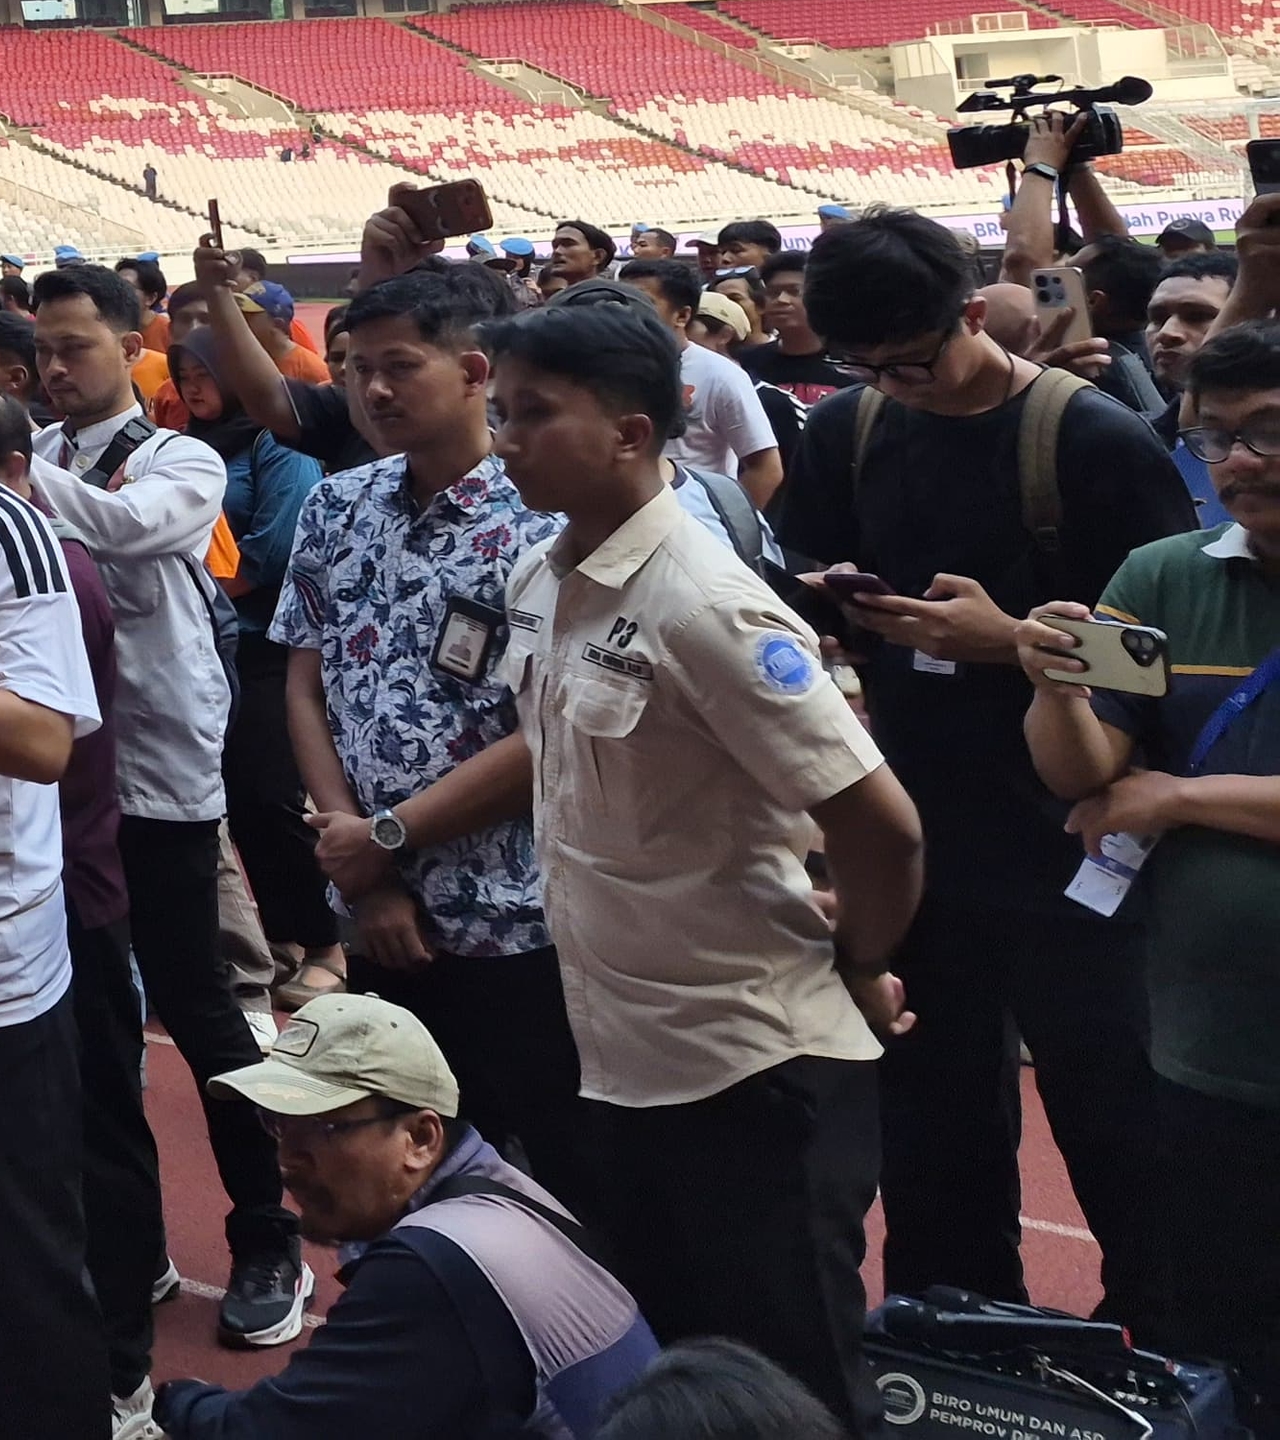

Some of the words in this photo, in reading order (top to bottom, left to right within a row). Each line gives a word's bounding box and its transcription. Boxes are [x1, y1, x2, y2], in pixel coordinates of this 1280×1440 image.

[606, 616, 638, 649] P3
[929, 1408, 1007, 1438] PEMPROV
[931, 1391, 972, 1412] BIRO
[975, 1402, 1025, 1427] UMUM
[1028, 1416, 1066, 1437] DAN
